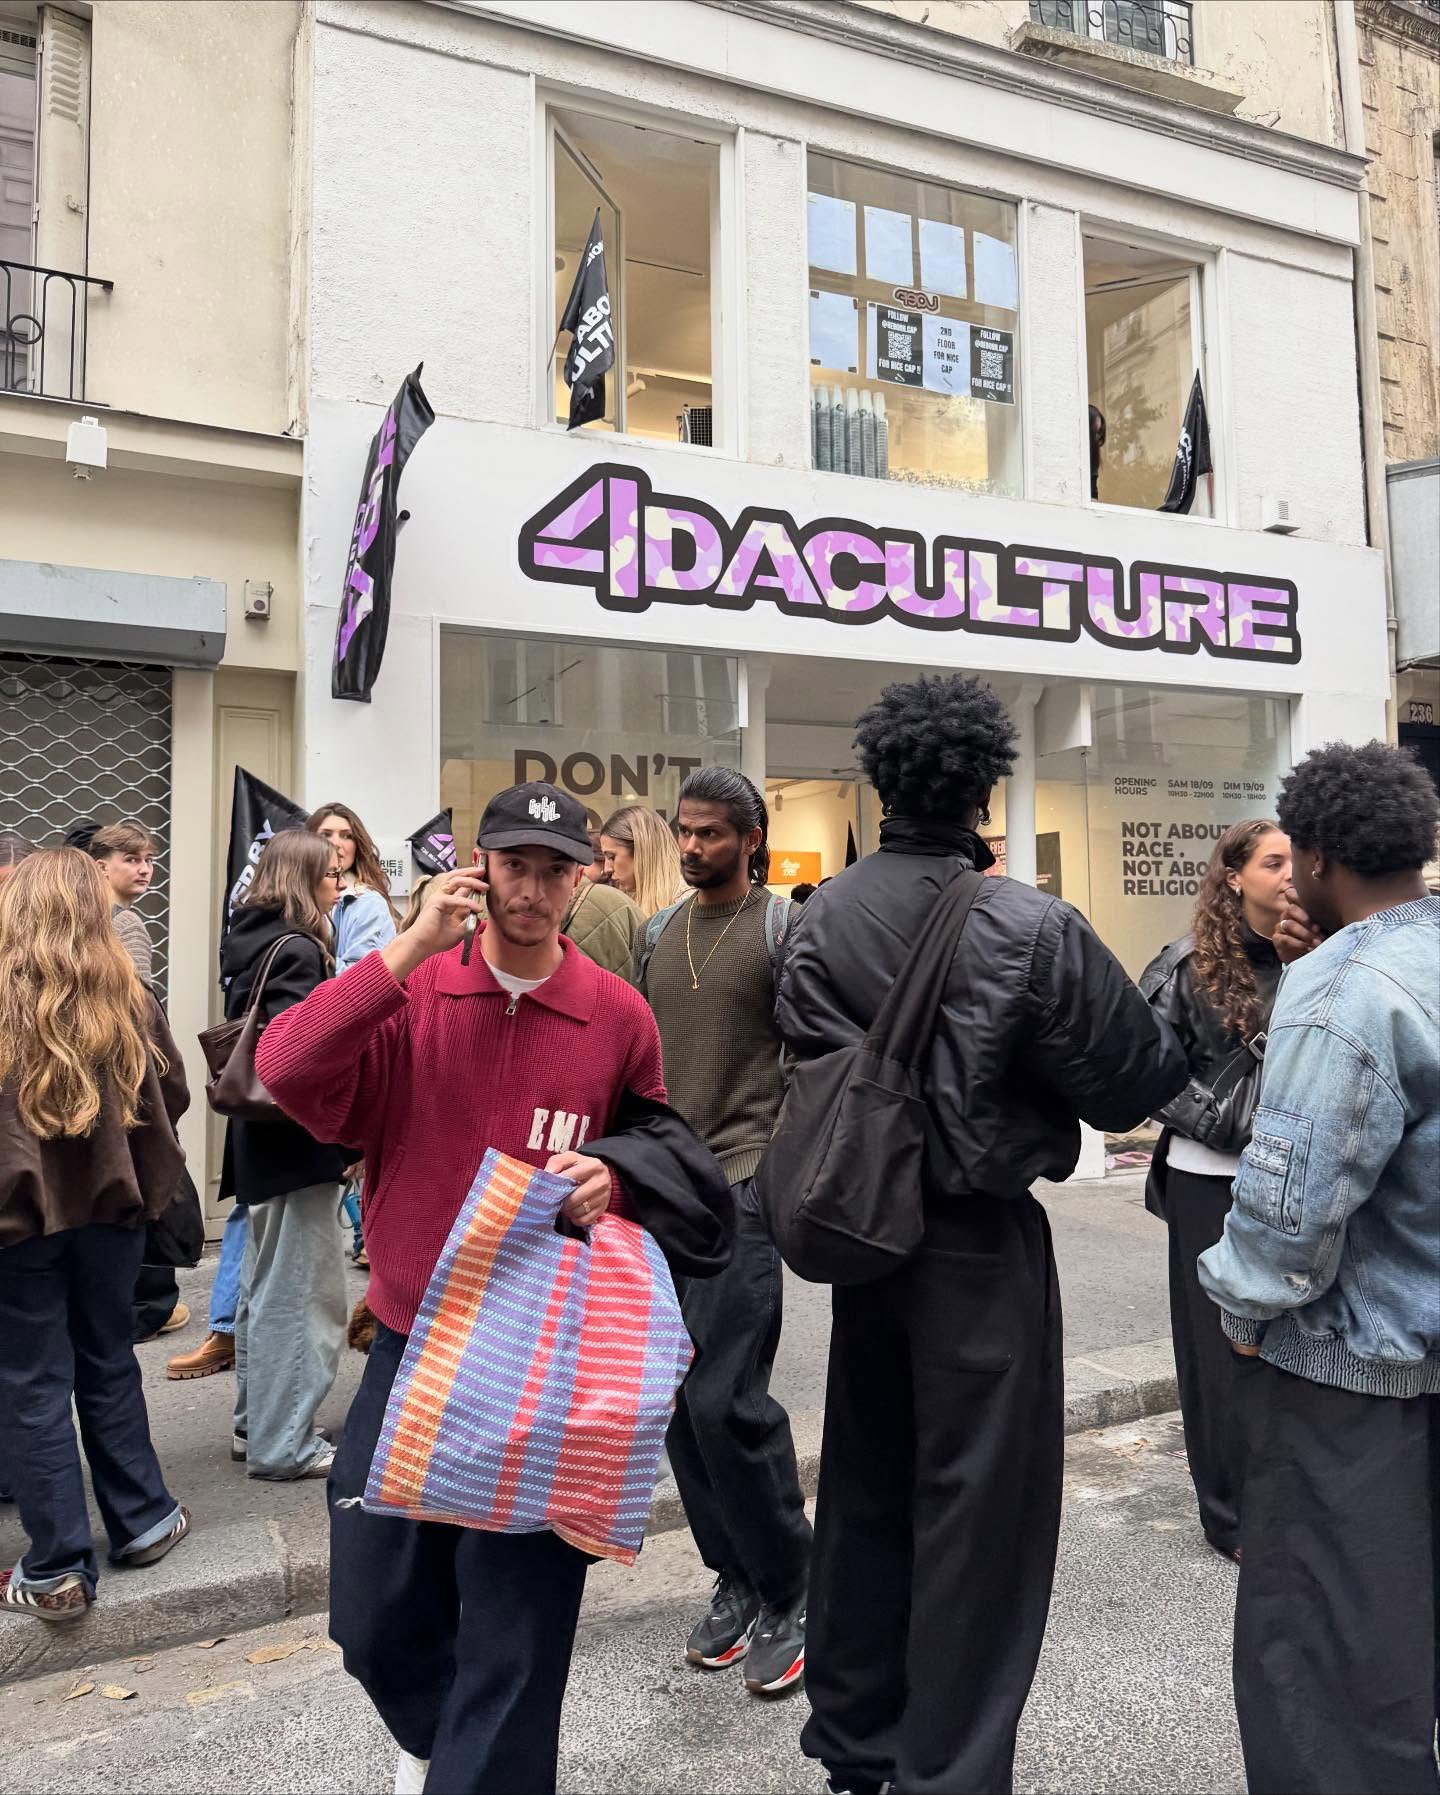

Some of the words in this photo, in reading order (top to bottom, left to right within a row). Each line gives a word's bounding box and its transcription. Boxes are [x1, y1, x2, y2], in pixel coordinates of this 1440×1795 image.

[577, 293, 612, 345] ABO
[887, 309, 909, 323] FOLLOW
[940, 326, 952, 337] 2ND
[980, 329, 1001, 342] FOLLOW
[937, 338, 956, 350] FLOOR
[933, 350, 945, 360] FOR
[946, 352, 960, 364] NICE
[878, 358, 891, 369] FOR
[890, 360, 904, 372] NICE
[904, 363, 917, 374] CAP
[941, 364, 953, 375] CAP
[971, 377, 983, 388] FOR
[983, 379, 996, 391] NICE
[995, 381, 1008, 392] CAP
[523, 466, 1298, 662] 4DACULTURE
[1410, 702, 1433, 724] 236
[514, 749, 702, 796] DON'T
[1114, 776, 1157, 788] OPENING
[1167, 779, 1188, 789] SAM
[1190, 779, 1214, 791] 18/09
[1223, 781, 1241, 791] DIM
[1242, 782, 1265, 794] 19/09
[1114, 786, 1148, 796] HOURS
[1167, 790, 1188, 798] 10H30
[1121, 821, 1162, 839] NOT
[1122, 841, 1174, 858] RACE
[1123, 860, 1163, 877] NOT
[1168, 861, 1208, 877] ABO
[1123, 879, 1200, 896] RELIGIO
